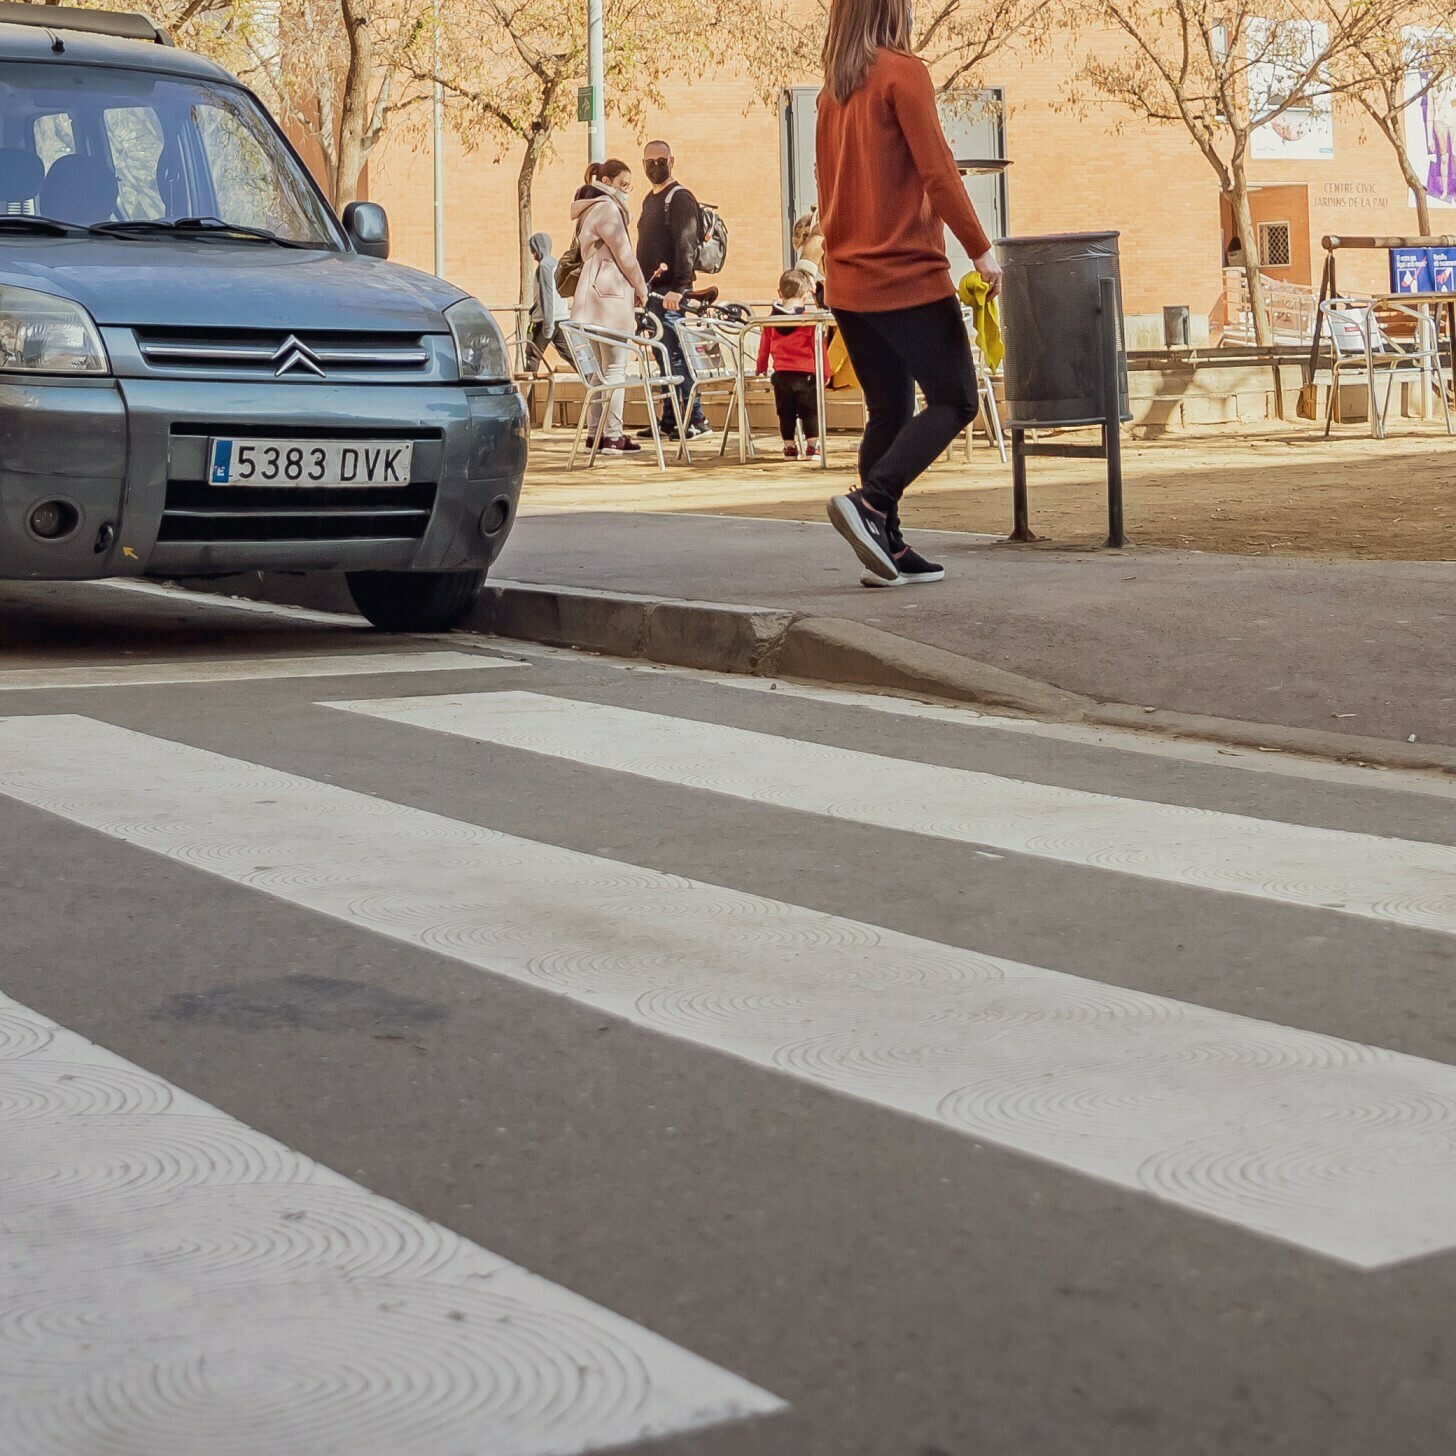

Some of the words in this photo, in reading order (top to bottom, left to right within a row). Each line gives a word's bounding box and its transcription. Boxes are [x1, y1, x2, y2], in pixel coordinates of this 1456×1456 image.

[1324, 182, 1354, 194] CENTRE
[1314, 196, 1347, 208] JARDINS
[1348, 196, 1359, 208] DE
[1361, 196, 1372, 208] LA
[237, 445, 327, 481] 5383
[339, 447, 403, 482] DVK
[216, 465, 225, 477] E
